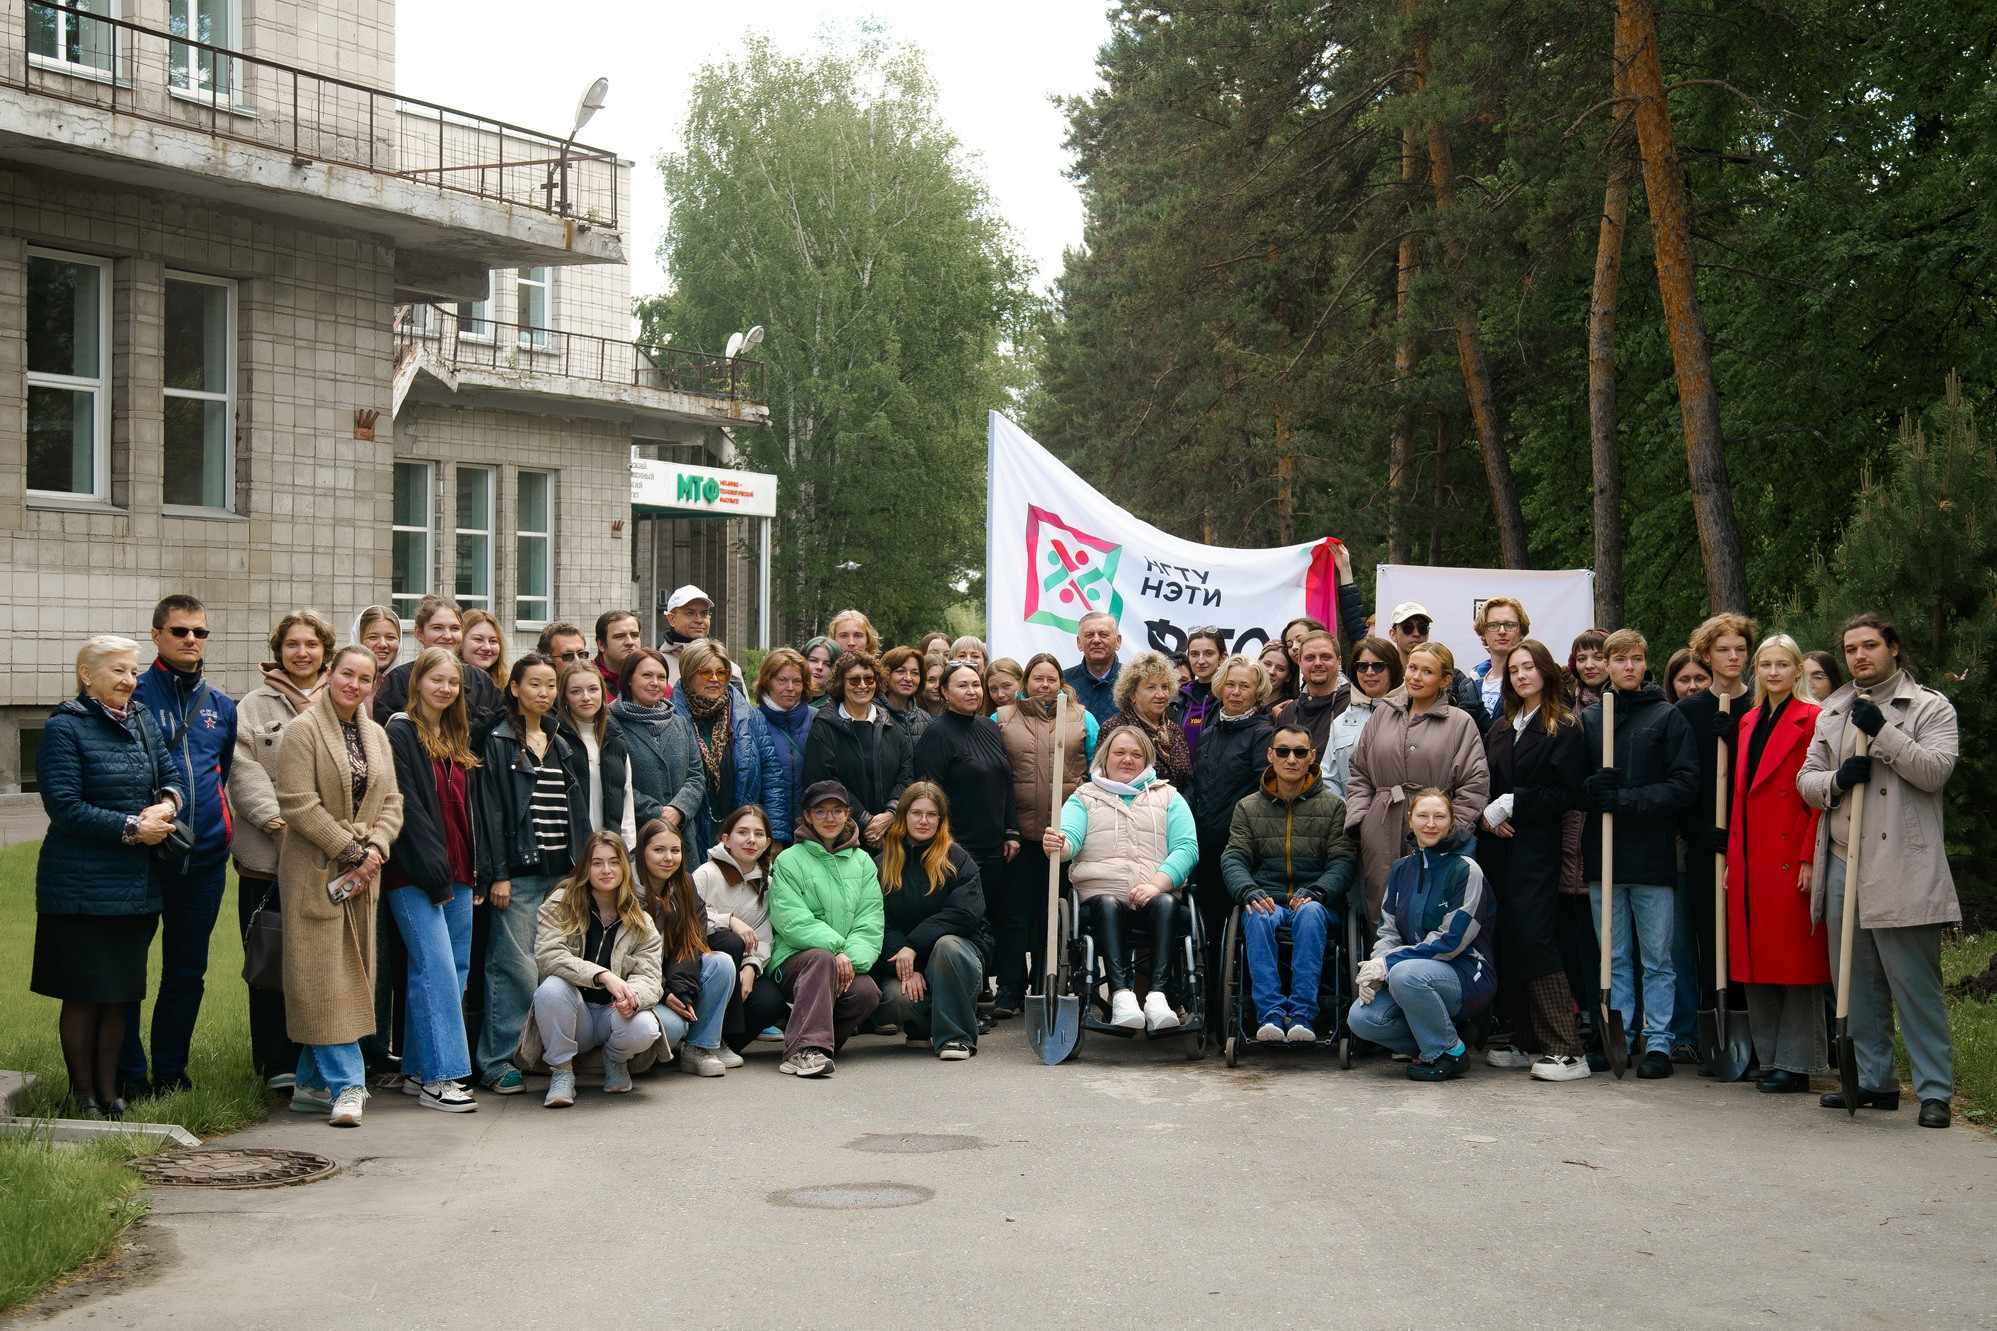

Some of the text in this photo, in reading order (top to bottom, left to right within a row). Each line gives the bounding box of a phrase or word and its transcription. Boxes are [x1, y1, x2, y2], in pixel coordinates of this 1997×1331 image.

[677, 473, 720, 503] МТФ
[1143, 555, 1209, 584] НГТУ
[1141, 577, 1222, 607] НЭТИ
